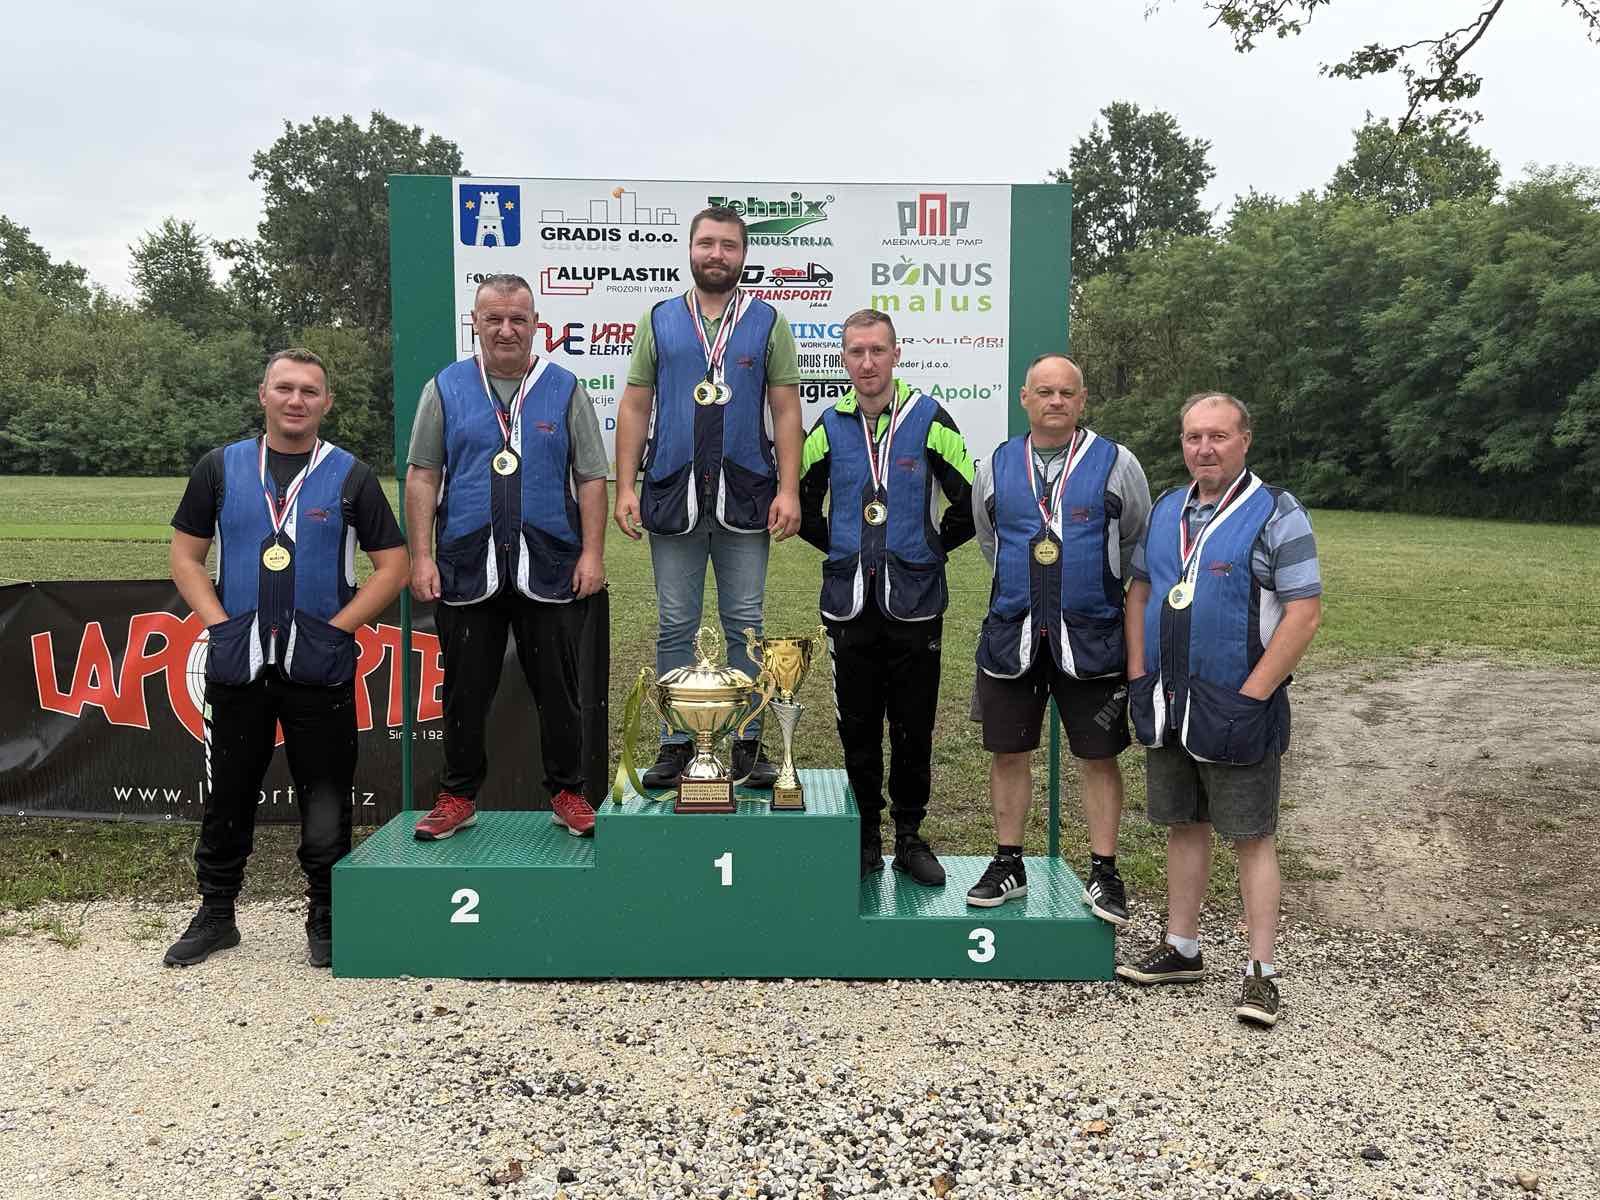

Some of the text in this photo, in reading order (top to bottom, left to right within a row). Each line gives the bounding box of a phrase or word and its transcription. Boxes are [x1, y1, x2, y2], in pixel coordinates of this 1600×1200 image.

[540, 227, 678, 243] GRADIS d.o.o.
[749, 236, 832, 247] NDUSTRIJA
[956, 238, 983, 247] PMP
[557, 266, 680, 282] ALUPLASTIK
[871, 258, 993, 287] BONUS
[606, 285, 642, 293] PROZORI
[649, 286, 673, 294] VRATA
[744, 289, 832, 301] TRANSPORTI
[871, 288, 992, 312] malus
[591, 323, 637, 344] VAR
[590, 344, 633, 355] ELEKTR
[896, 359, 919, 369] eder
[423, 729, 444, 740] 192
[714, 852, 733, 886] 1
[450, 888, 480, 923] 2
[967, 927, 996, 963] 3
